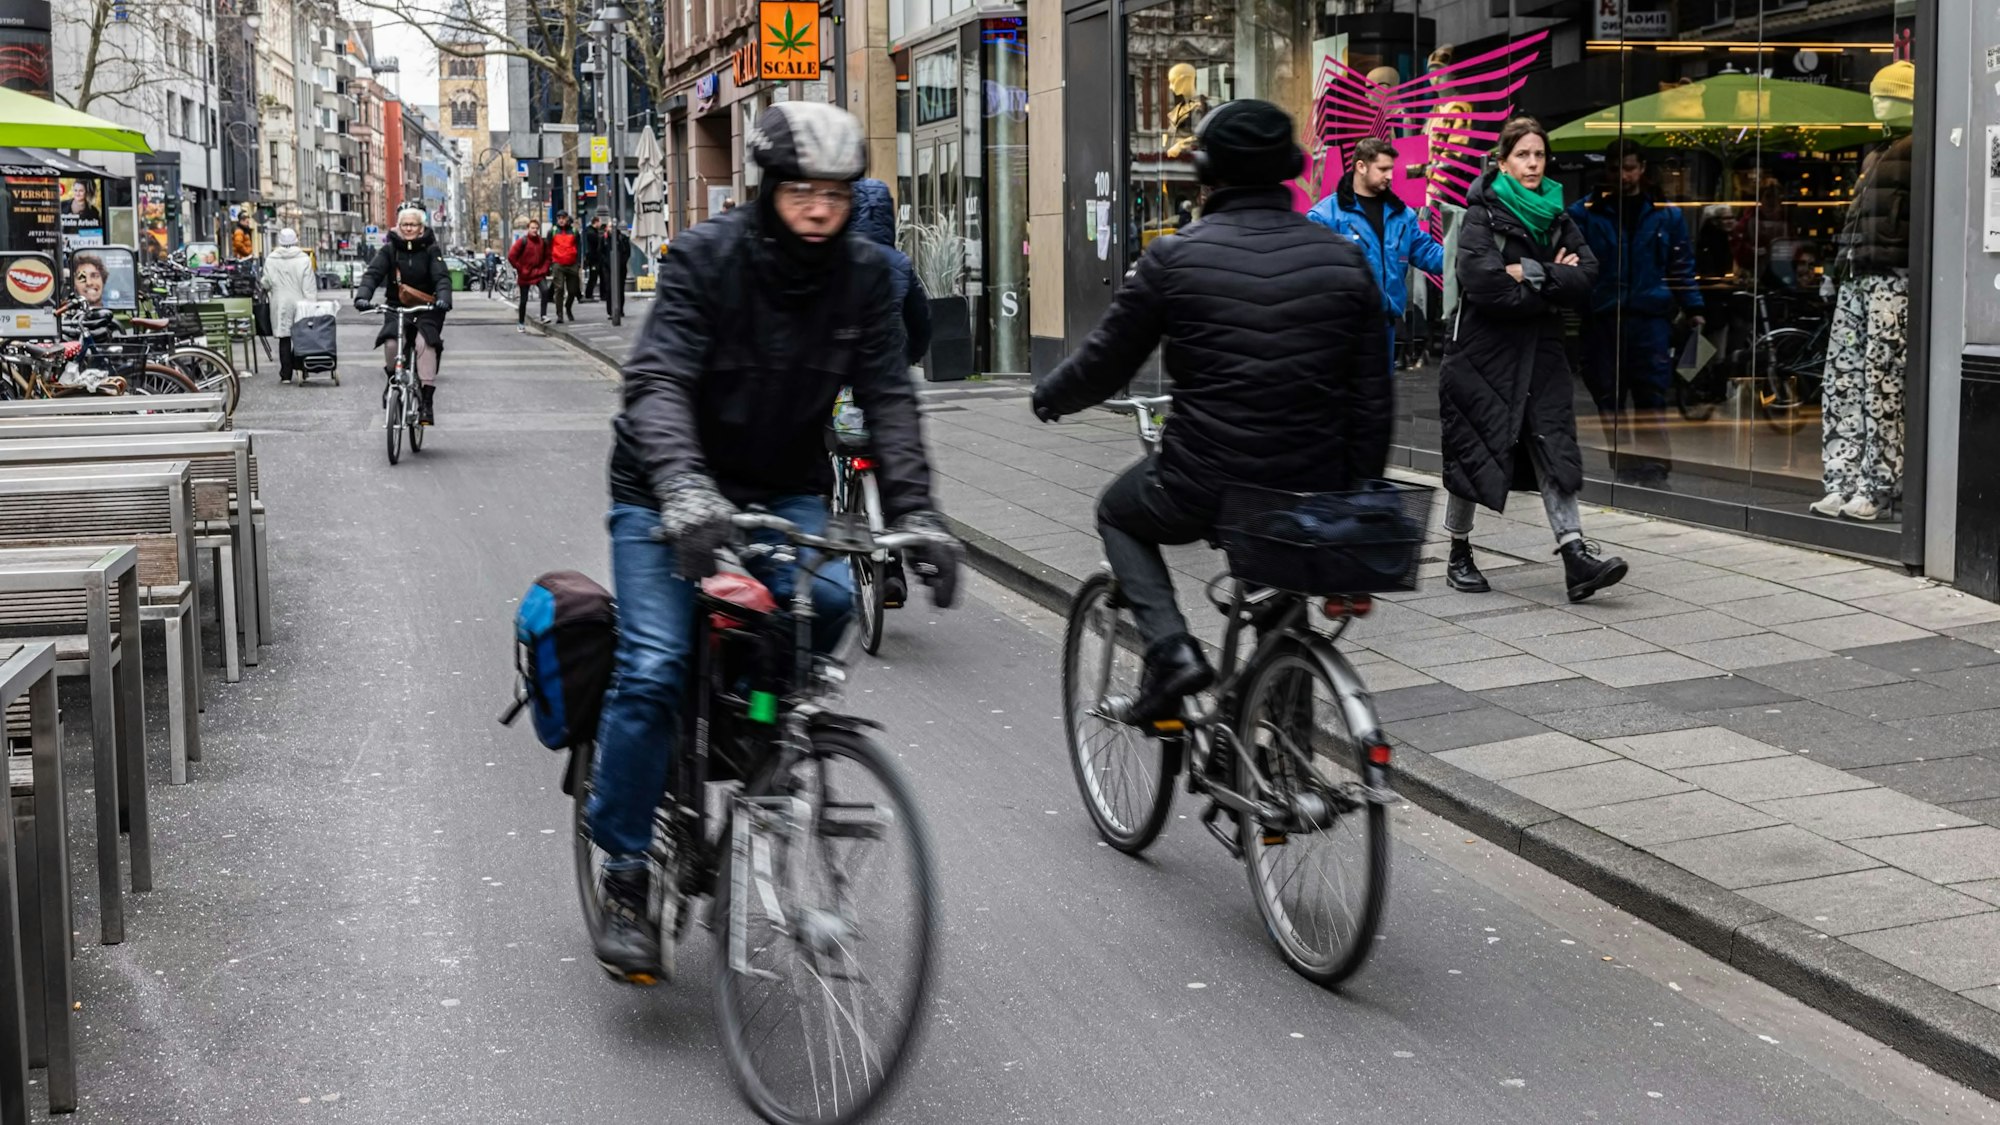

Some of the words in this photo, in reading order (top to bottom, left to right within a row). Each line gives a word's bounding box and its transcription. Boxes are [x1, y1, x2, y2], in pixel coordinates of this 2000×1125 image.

[763, 61, 817, 75] SCALE
[1094, 171, 1110, 197] 100
[1001, 291, 1019, 318] S
